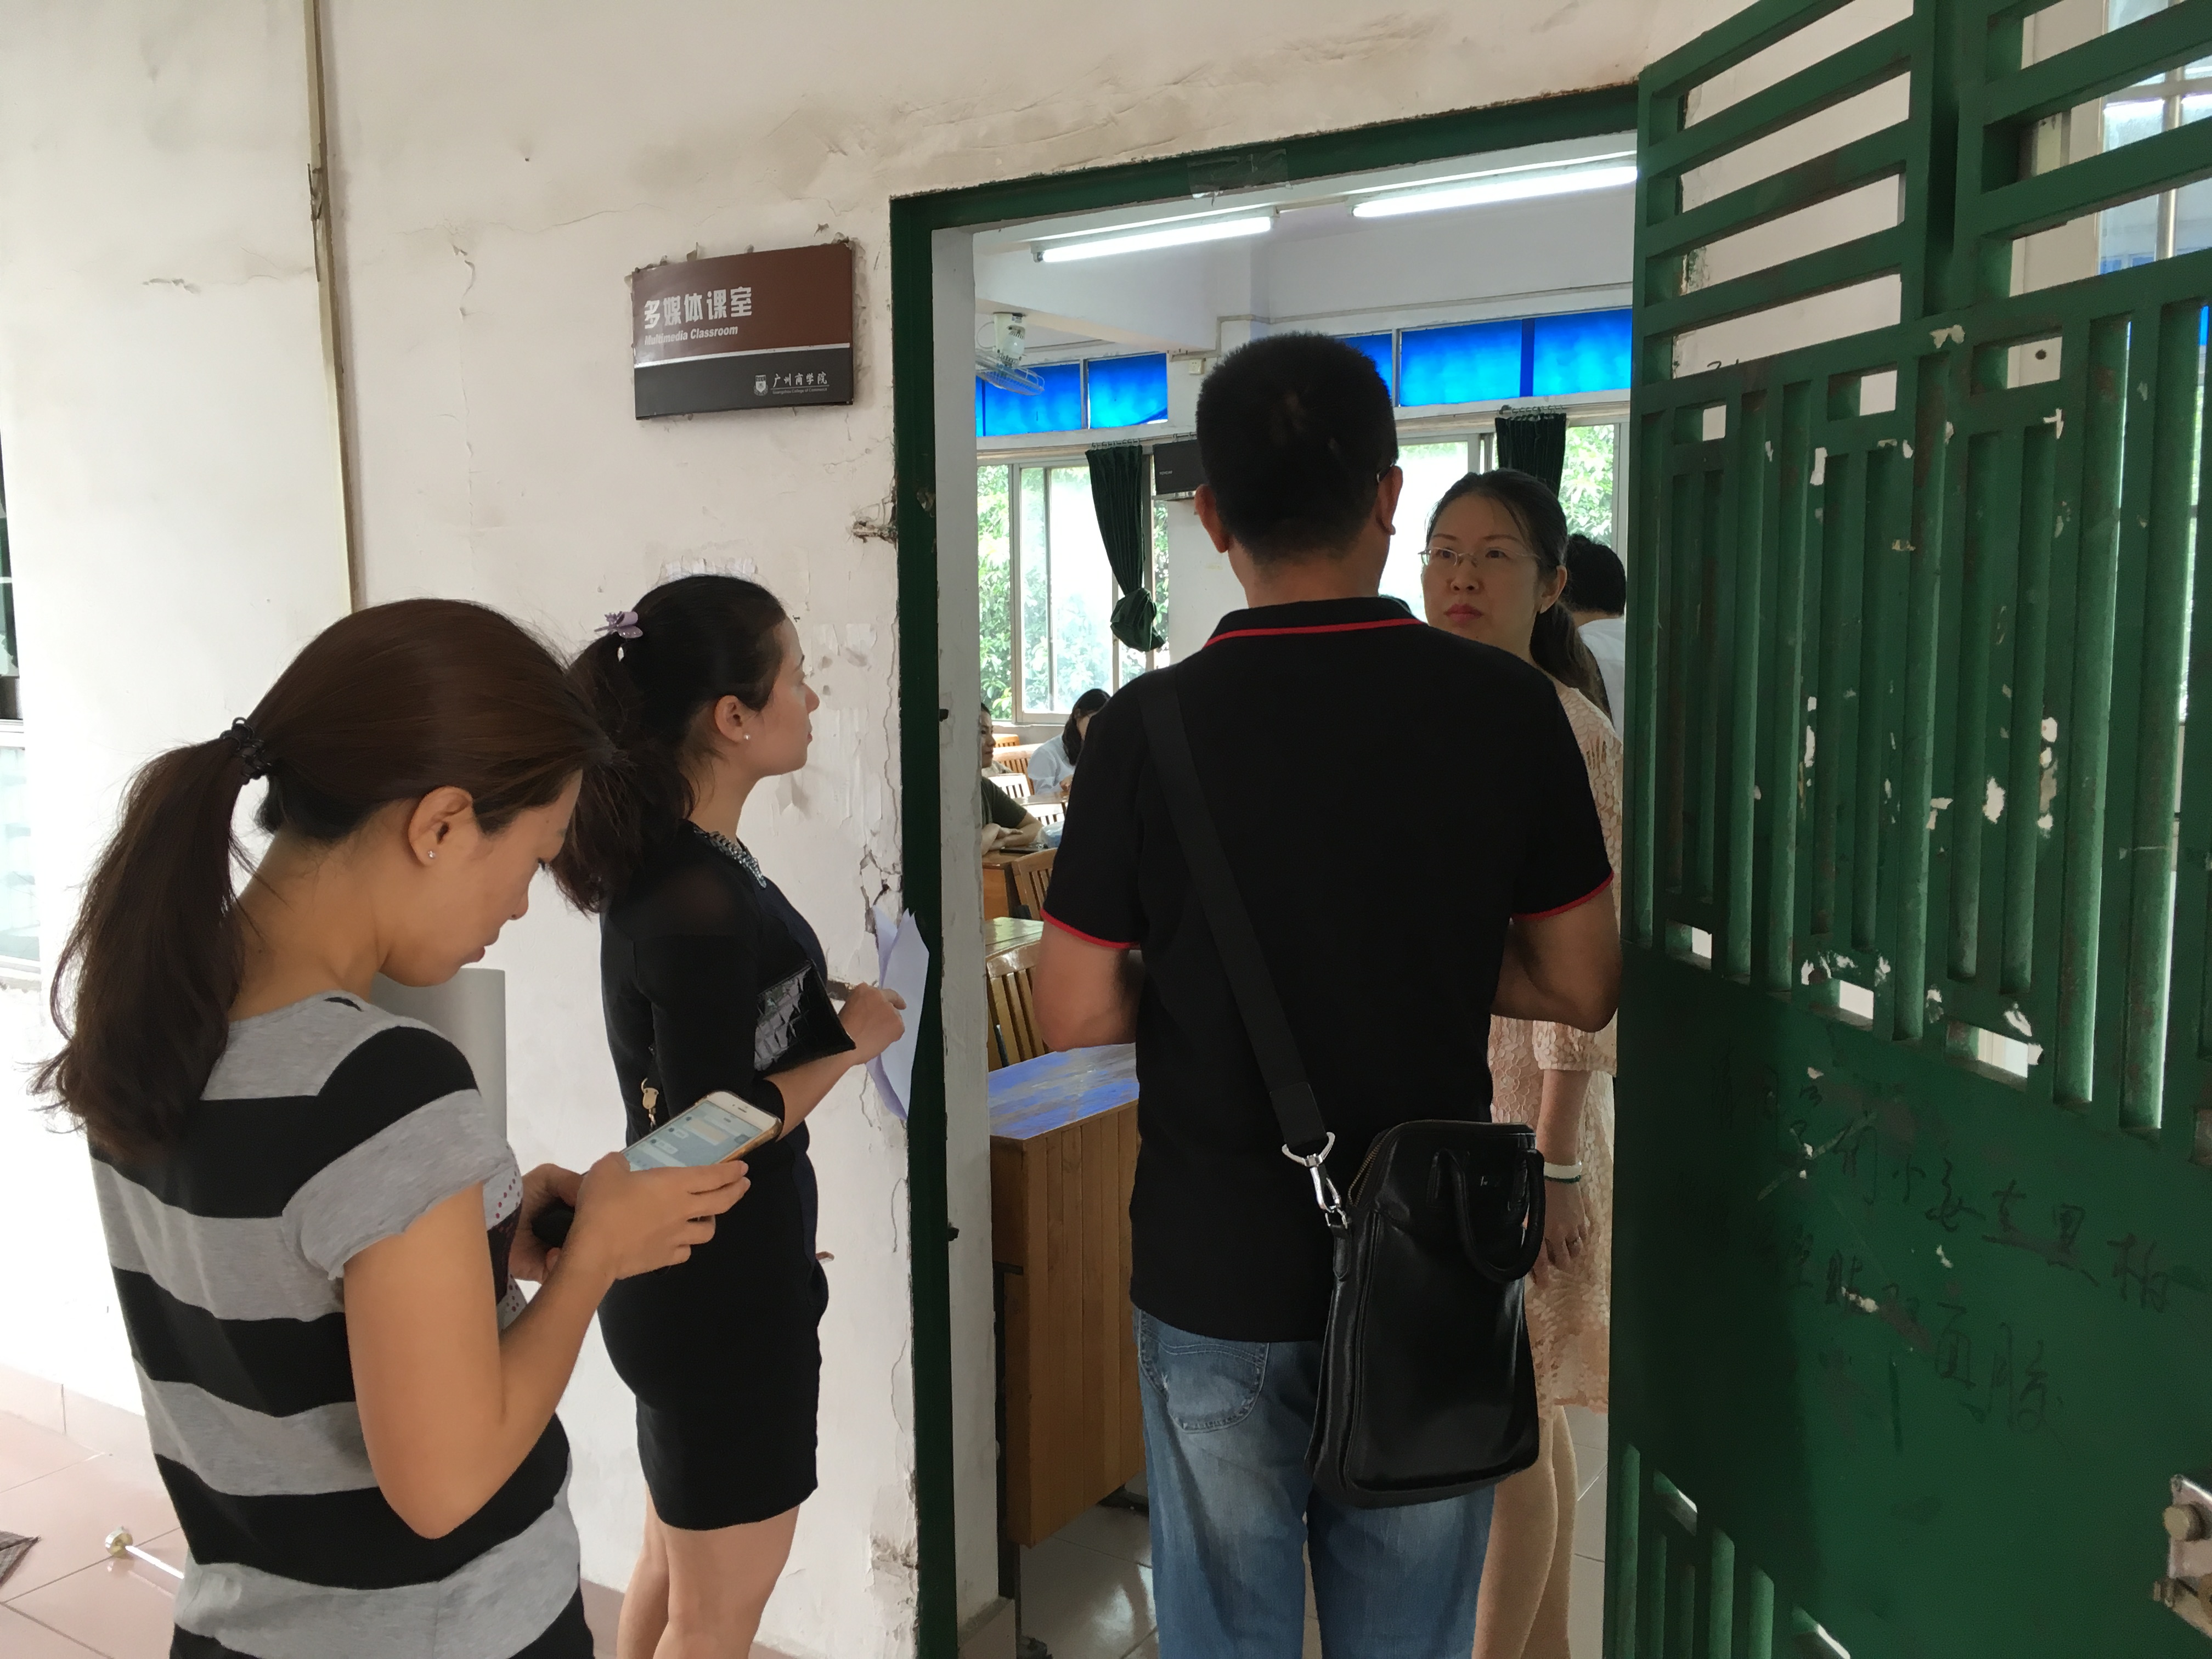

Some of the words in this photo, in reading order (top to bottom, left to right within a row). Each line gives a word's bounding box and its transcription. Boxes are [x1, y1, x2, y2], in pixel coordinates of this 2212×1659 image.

[644, 286, 752, 329] 多媒体课室
[645, 330, 688, 346] Multimedia
[690, 326, 738, 340] Classroom
[772, 371, 827, 388] 广州商学院
